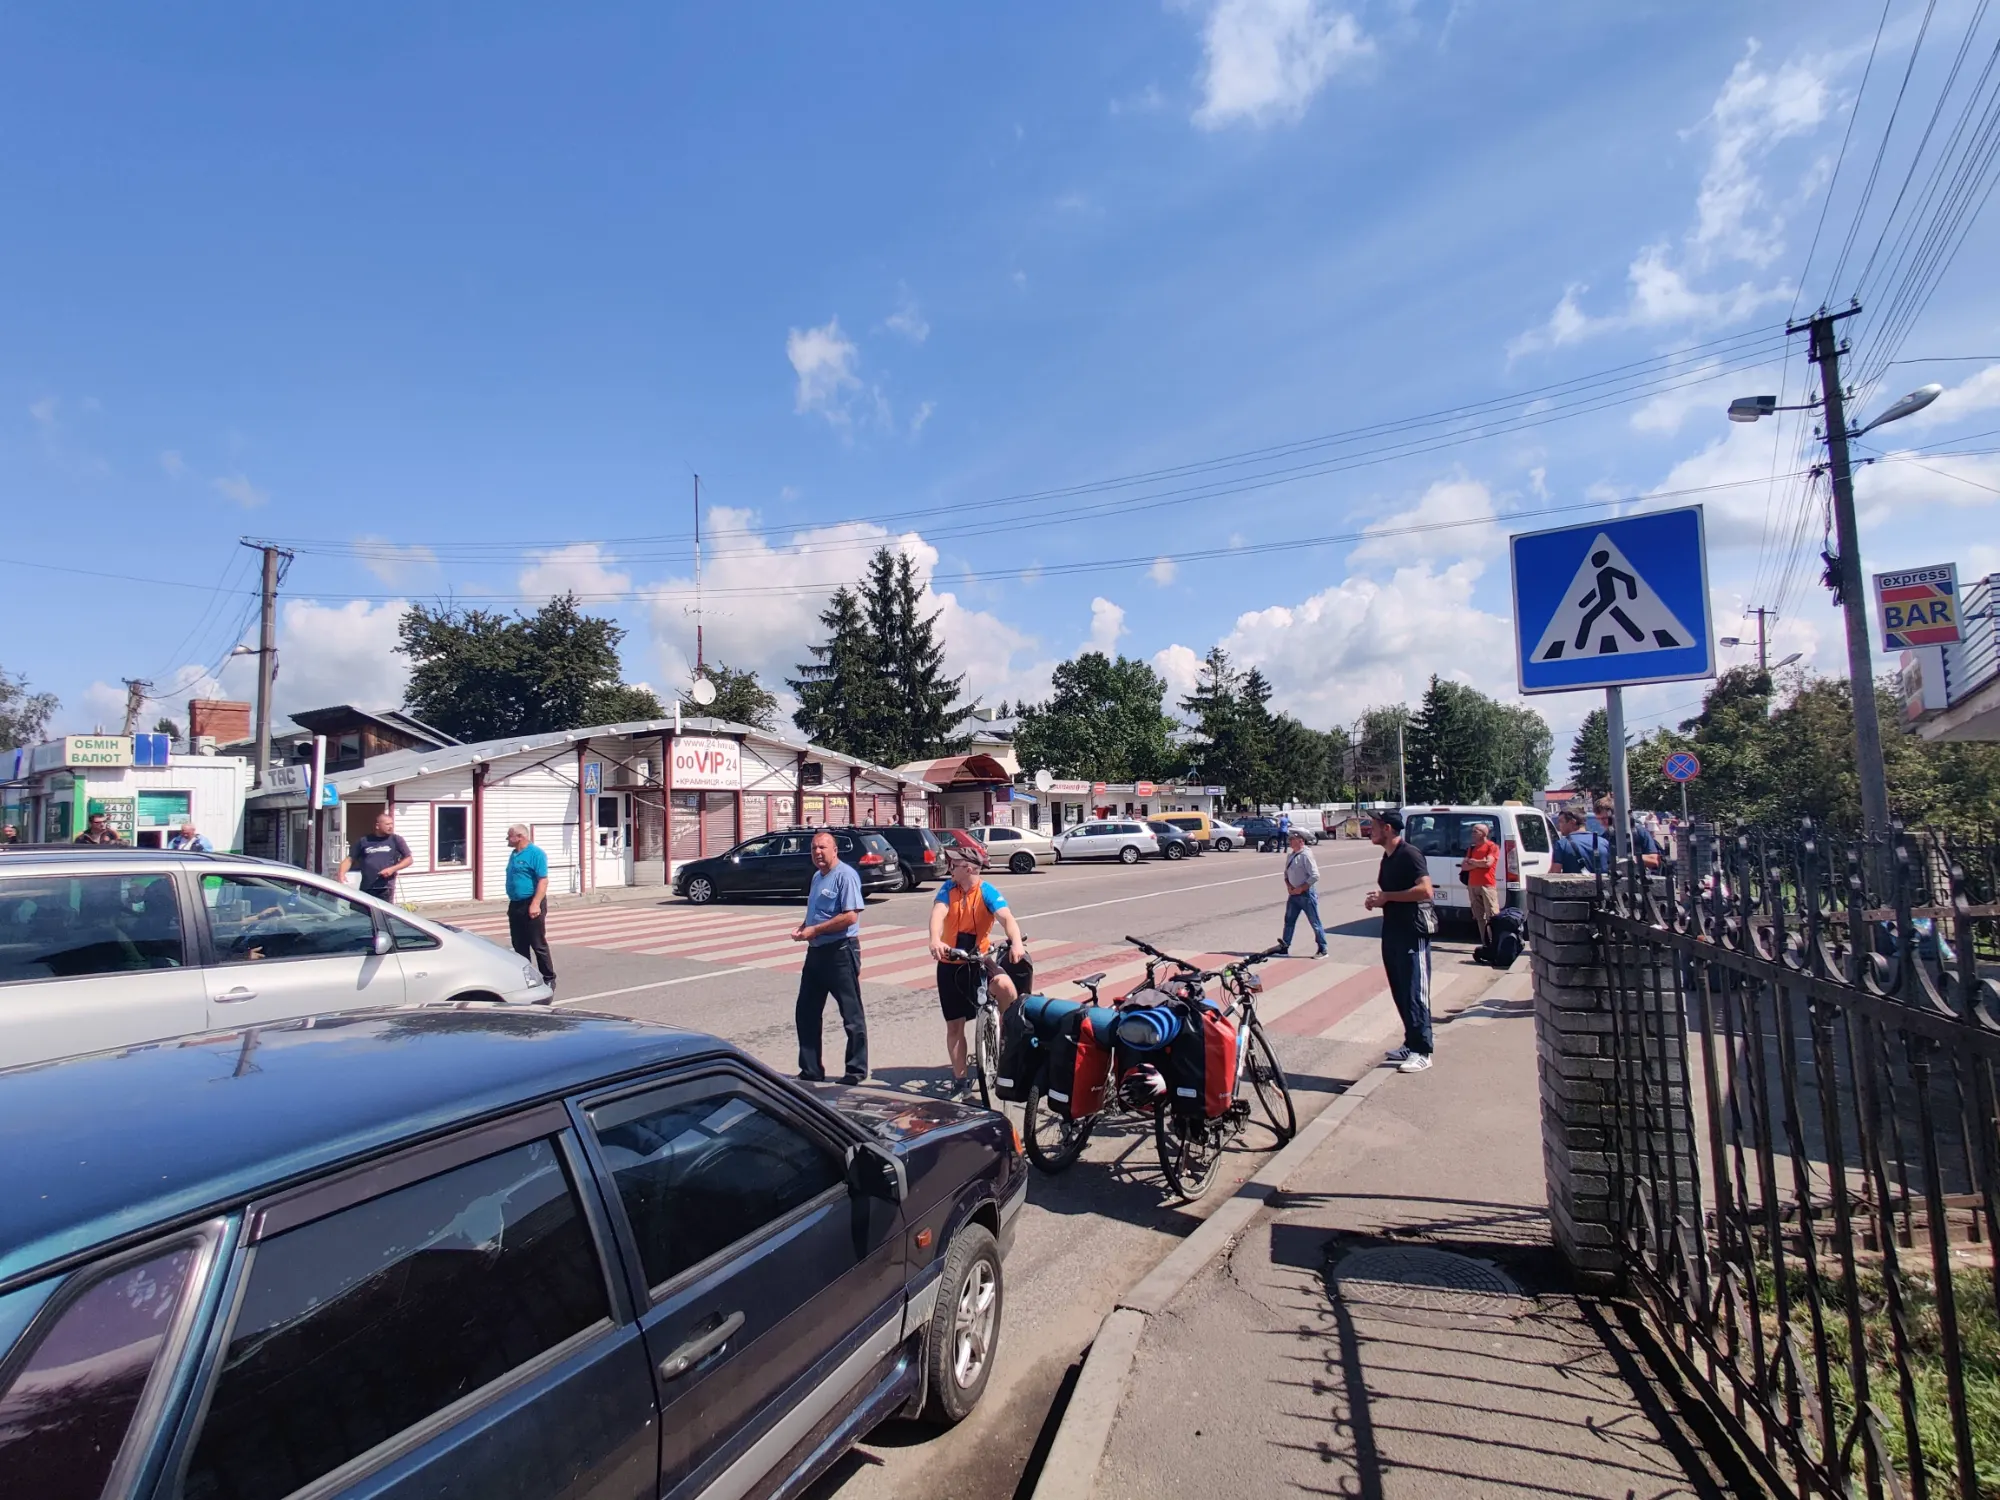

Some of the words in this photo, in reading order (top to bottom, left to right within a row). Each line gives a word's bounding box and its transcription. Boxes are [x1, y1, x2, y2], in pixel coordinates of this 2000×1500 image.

[1883, 569, 1947, 587] express
[1884, 601, 1952, 629] BAR
[74, 740, 119, 749] ОБМІН
[71, 753, 122, 763] ВАЛЮТ
